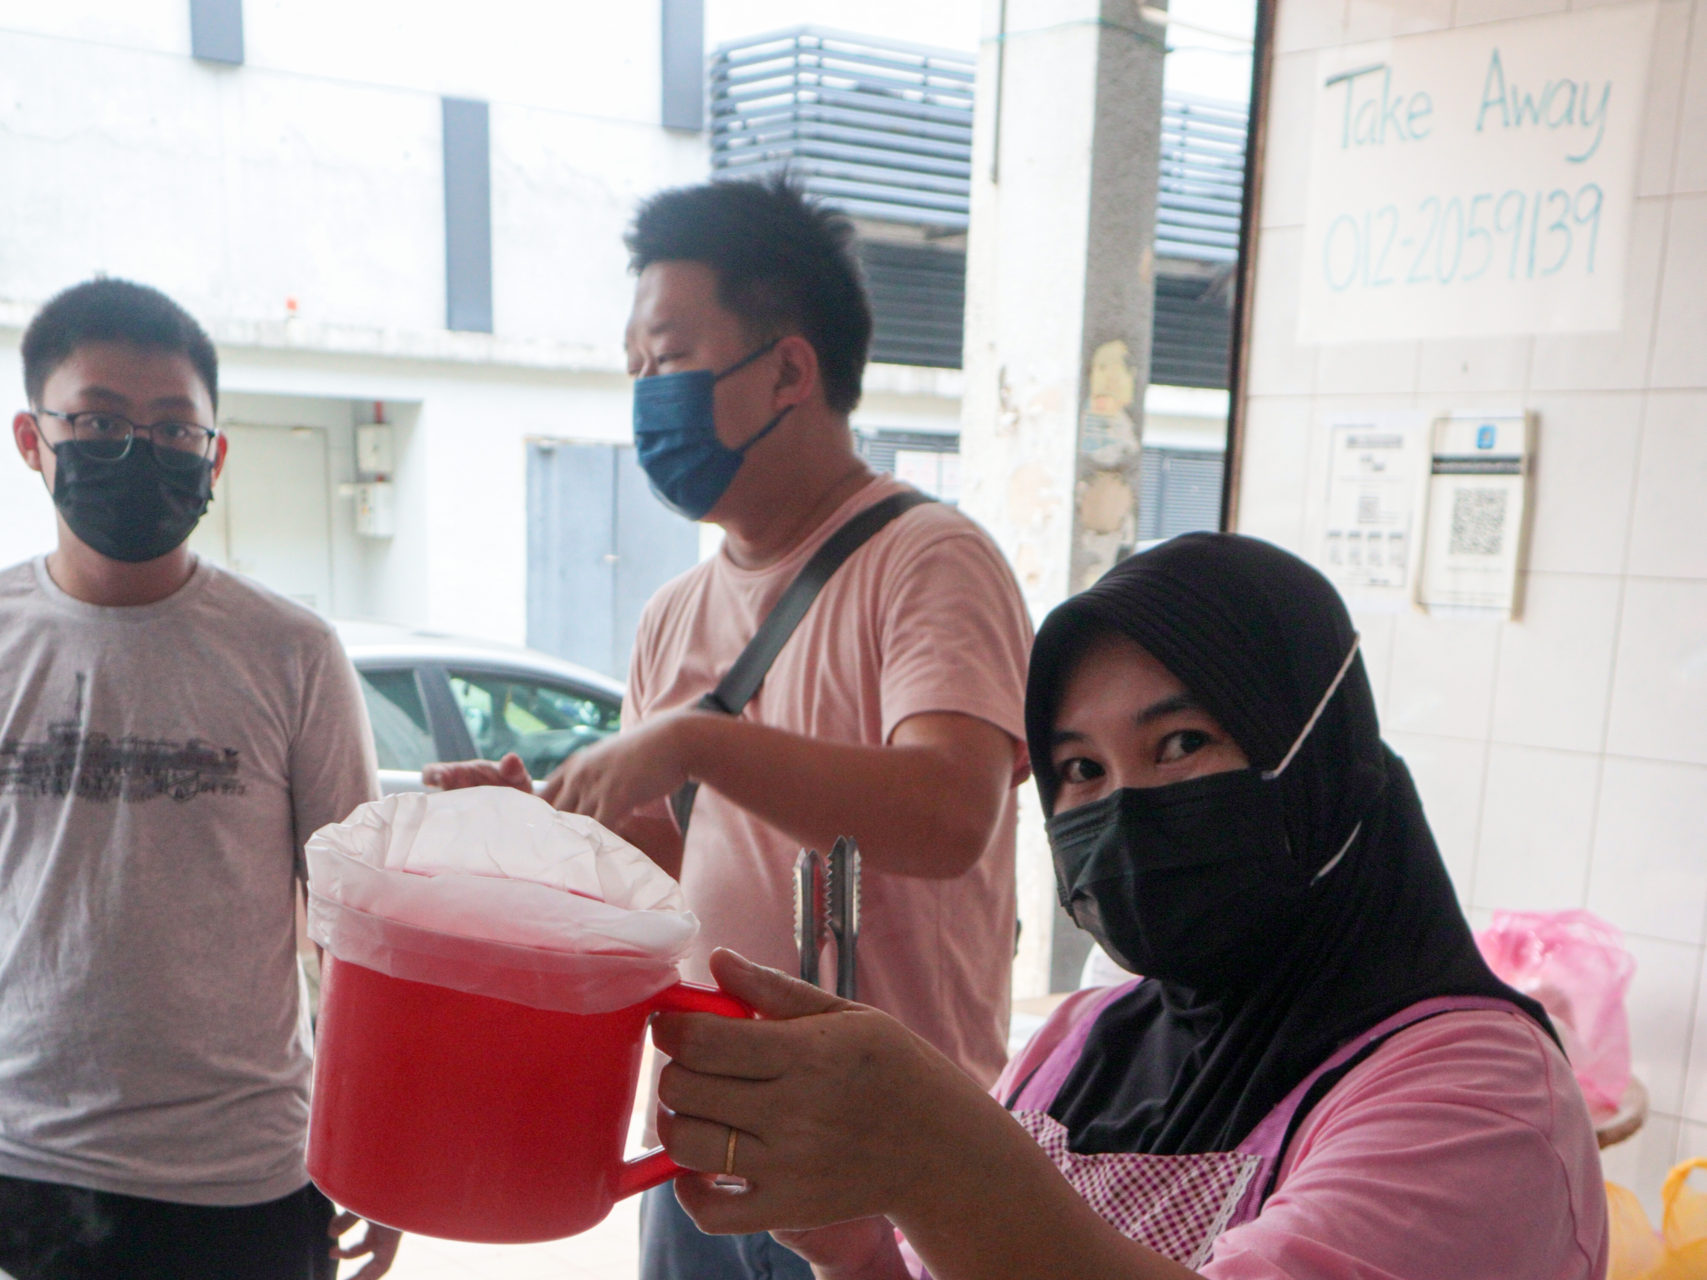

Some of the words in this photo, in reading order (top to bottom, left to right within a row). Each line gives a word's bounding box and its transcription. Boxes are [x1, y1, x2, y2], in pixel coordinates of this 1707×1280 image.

[1325, 62, 1433, 149] Take
[1476, 47, 1612, 163] Away
[1325, 183, 1604, 292] 012-2059139
